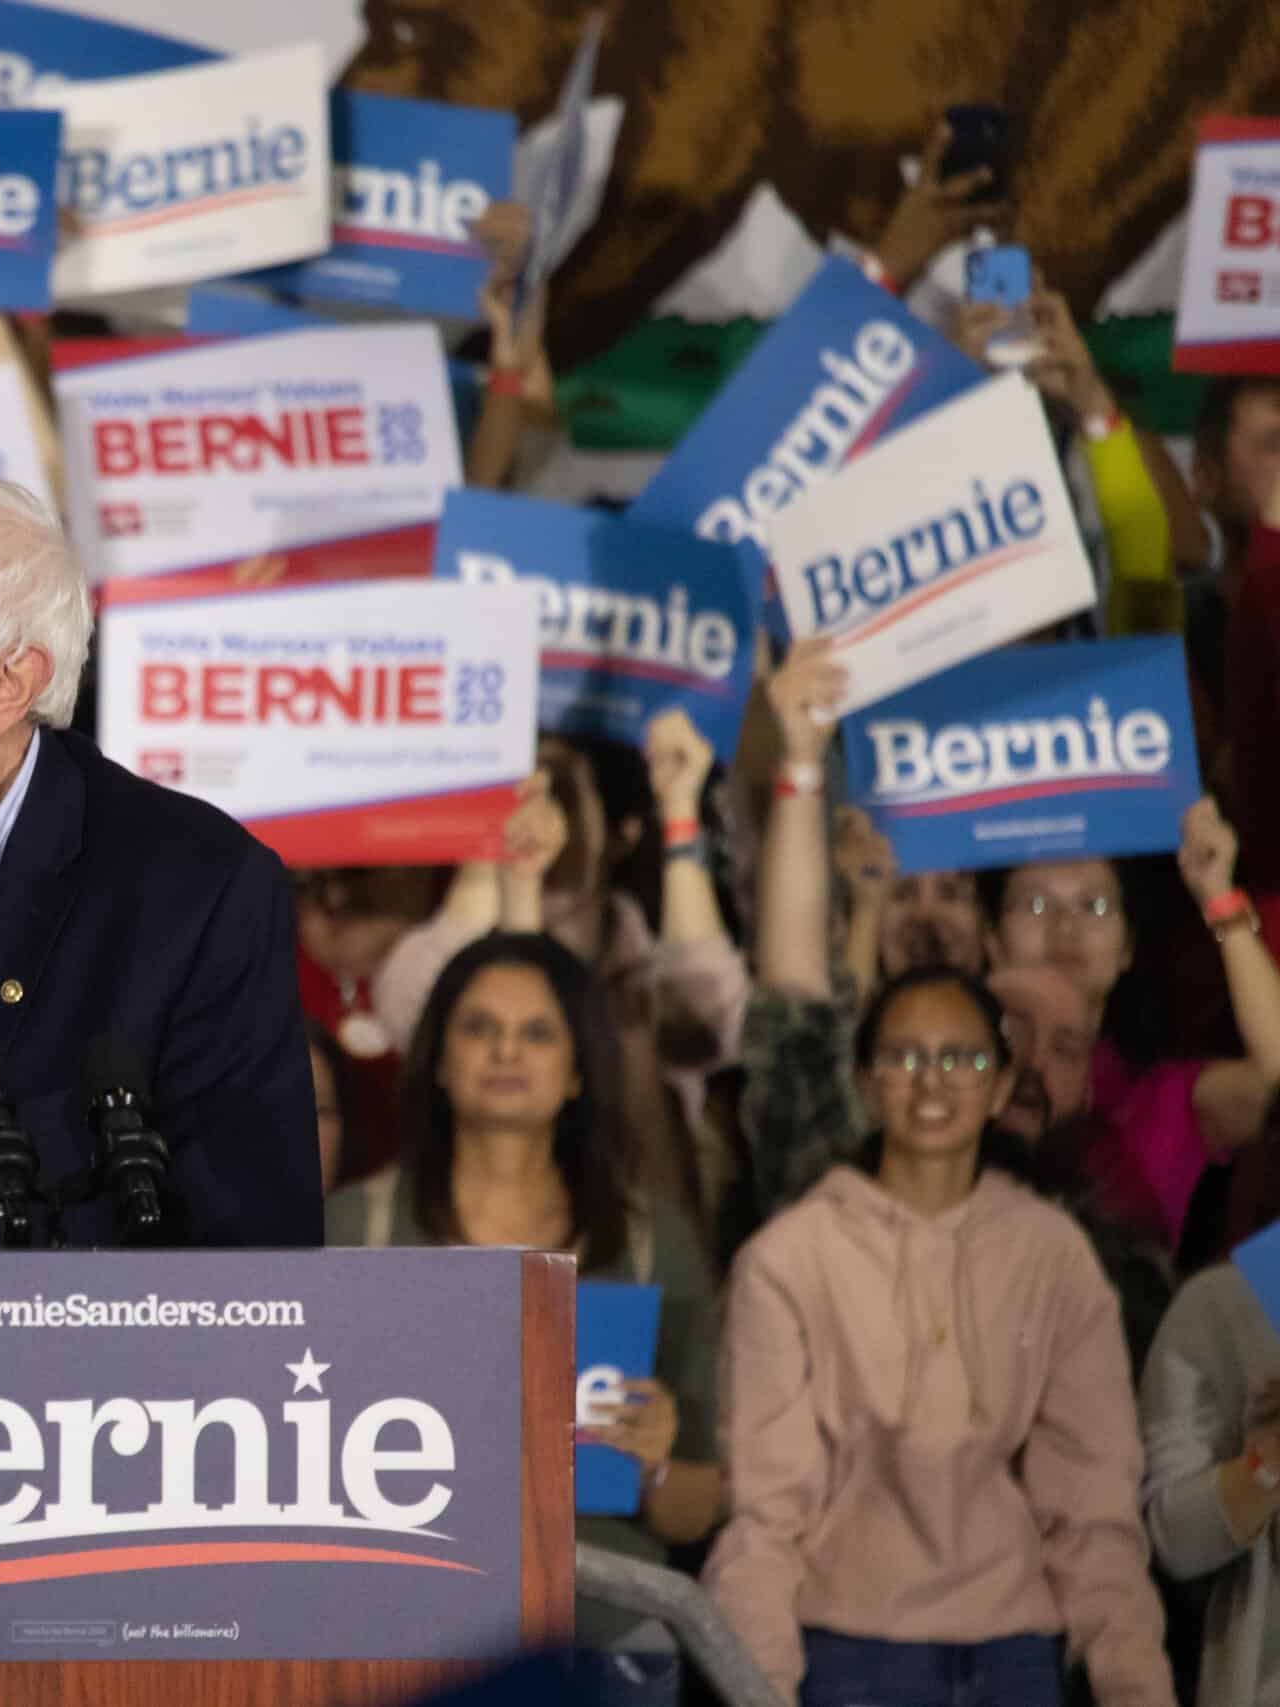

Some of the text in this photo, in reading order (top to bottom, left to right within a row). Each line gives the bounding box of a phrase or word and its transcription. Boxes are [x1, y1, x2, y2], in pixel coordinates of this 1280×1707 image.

[60, 116, 308, 210] Bernie
[92, 406, 371, 479] BERNIE
[804, 478, 1048, 626] Bernie
[140, 662, 447, 727] BERNIE
[867, 694, 1172, 796] Bernie
